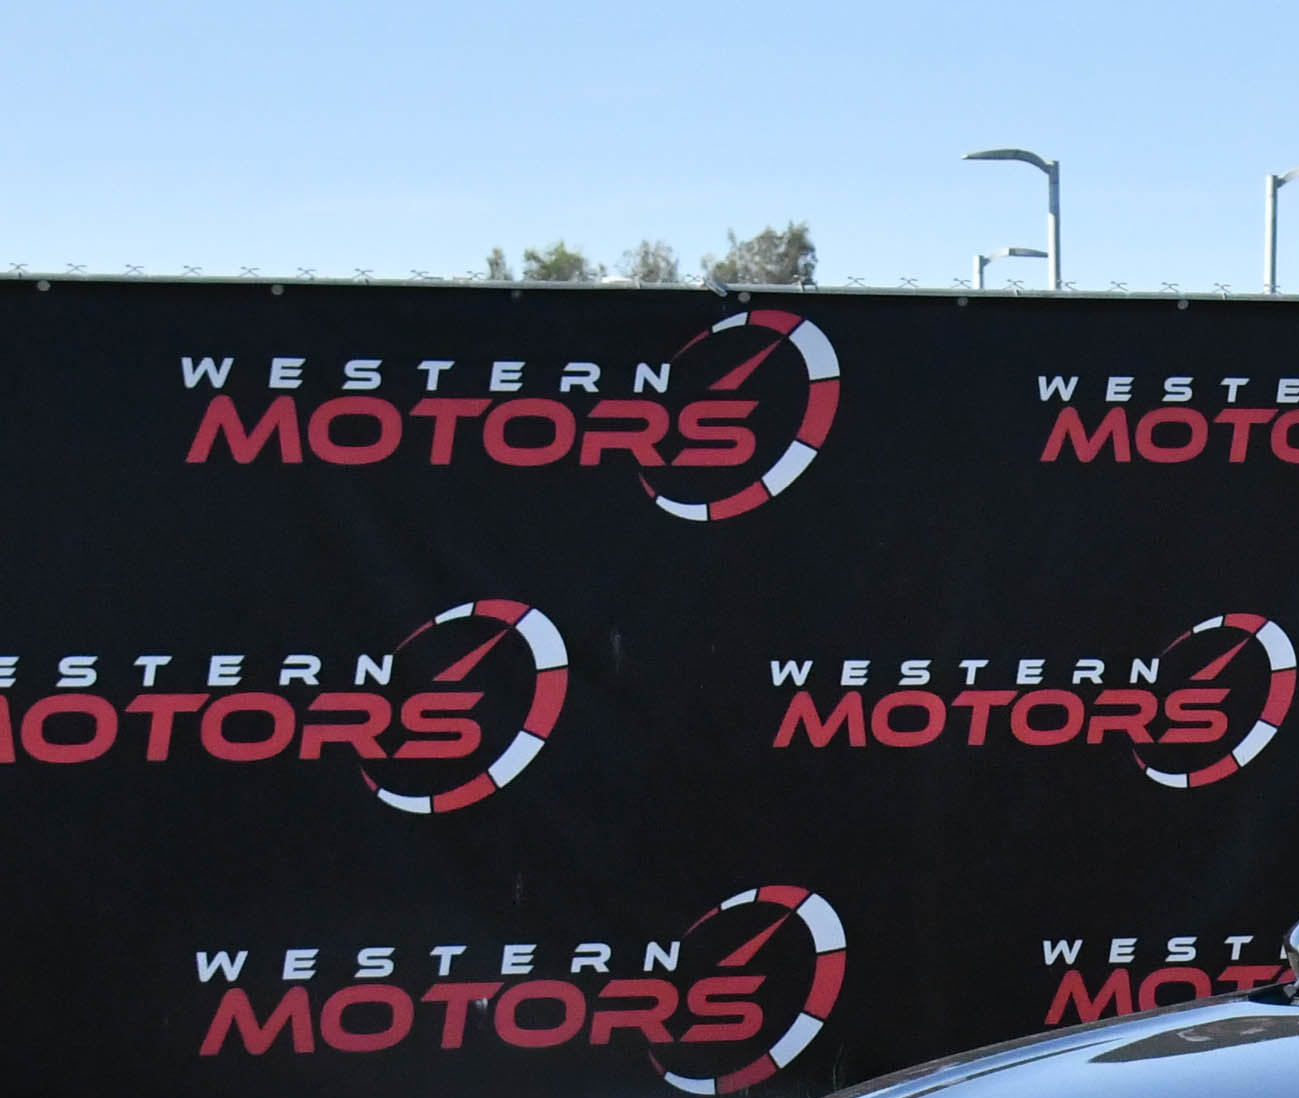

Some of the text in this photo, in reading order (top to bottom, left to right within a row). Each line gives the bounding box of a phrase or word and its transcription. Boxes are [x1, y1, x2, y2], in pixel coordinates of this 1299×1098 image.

[181, 356, 671, 393] WESTERN
[186, 395, 760, 467] MOTORS
[771, 657, 1161, 686] WESTERN
[0, 691, 484, 764] OTORS
[772, 689, 1230, 748] MOTORS
[195, 940, 682, 982] WESTERN
[1042, 935, 1287, 965] WEST
[199, 974, 766, 1056] MOTORS
